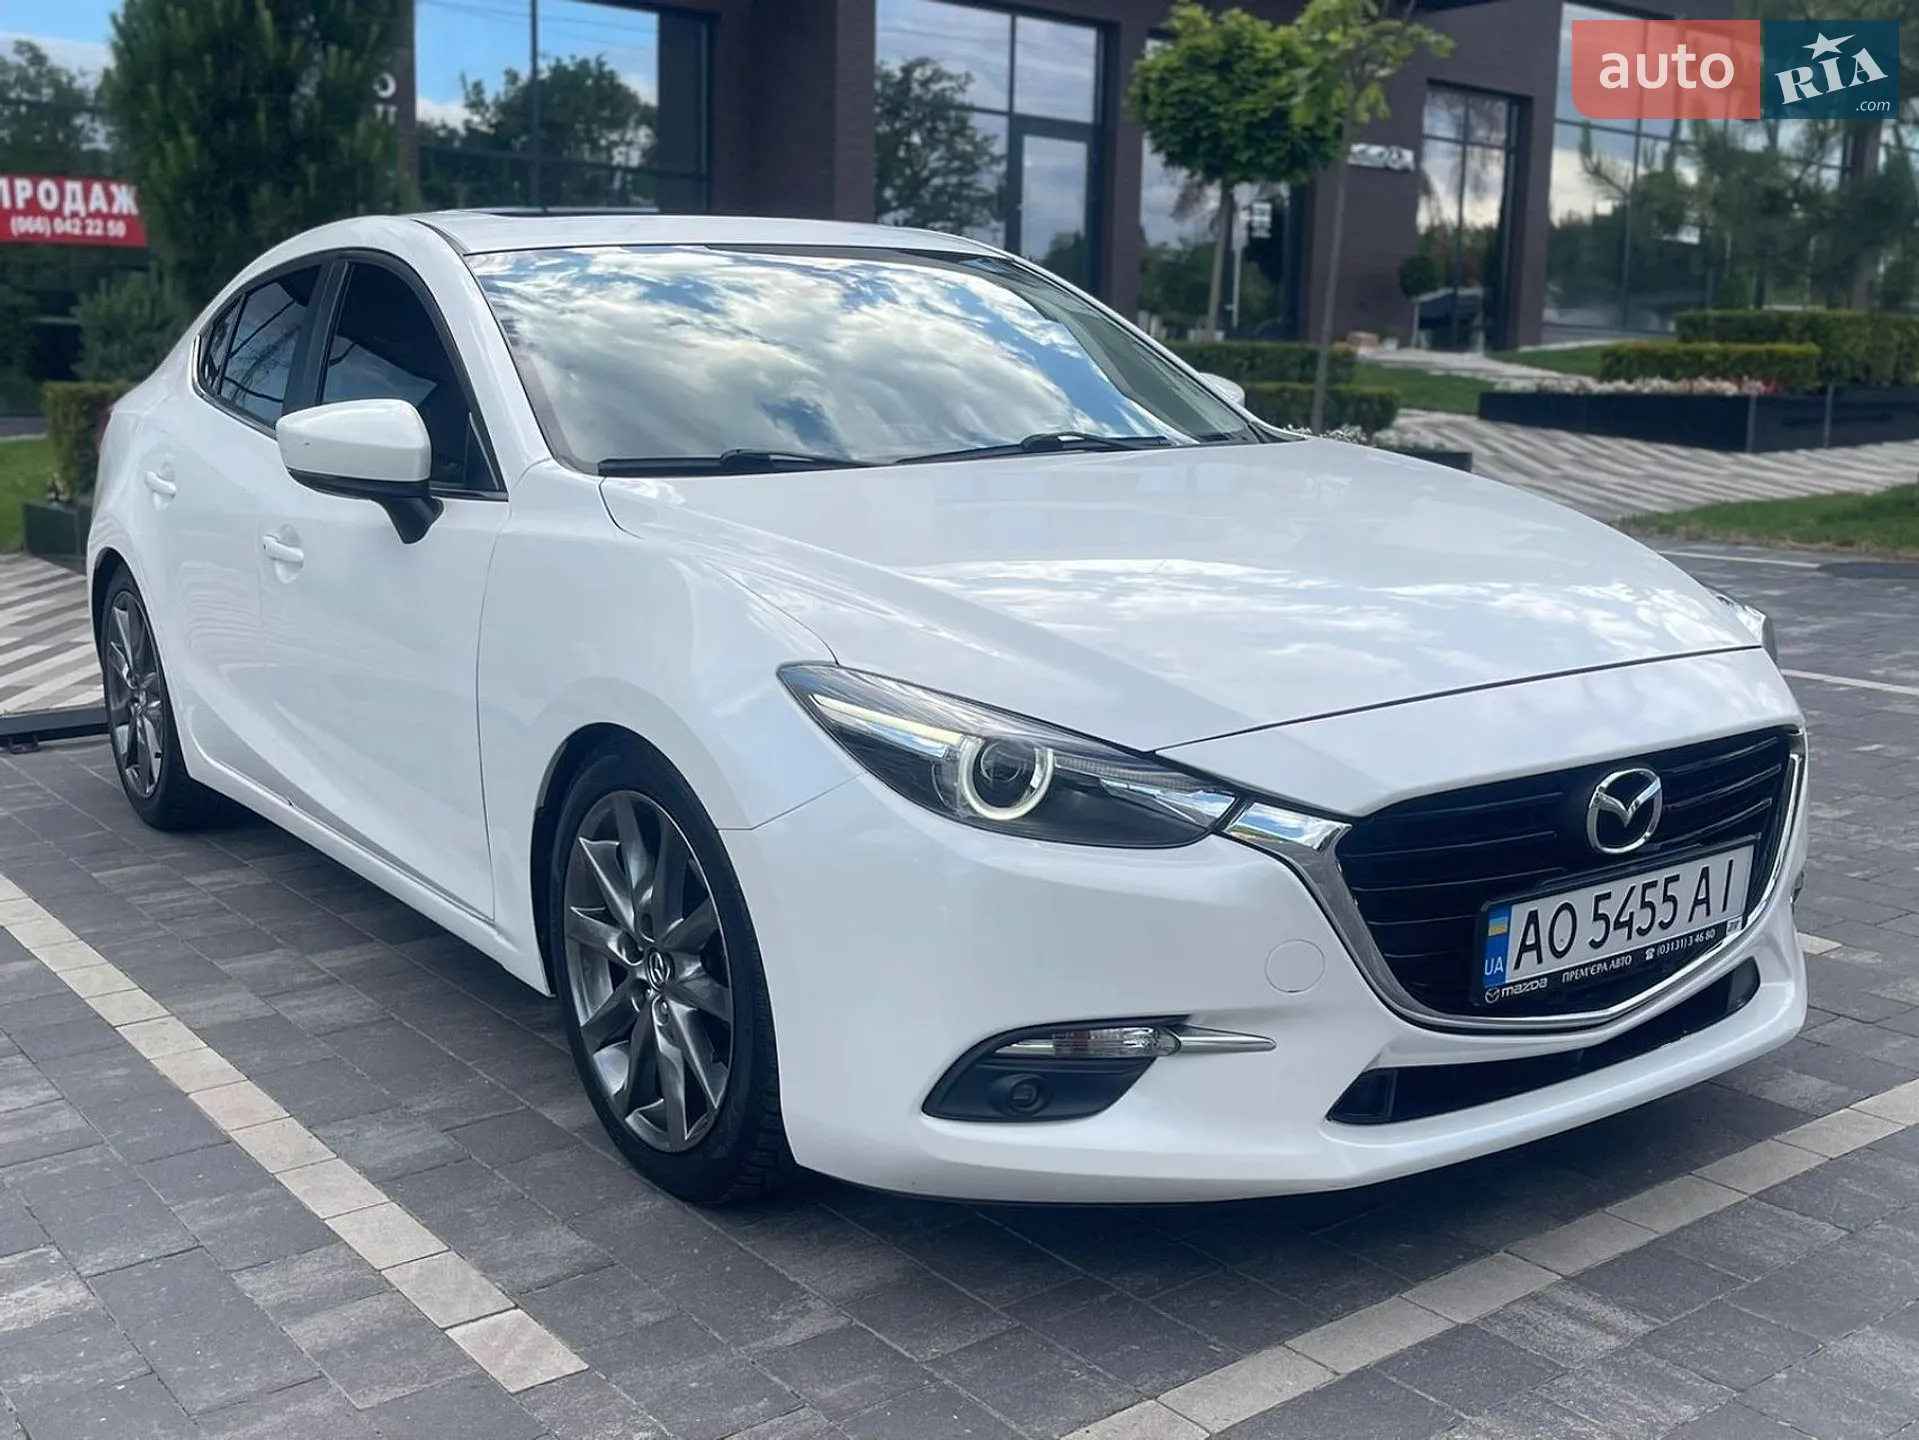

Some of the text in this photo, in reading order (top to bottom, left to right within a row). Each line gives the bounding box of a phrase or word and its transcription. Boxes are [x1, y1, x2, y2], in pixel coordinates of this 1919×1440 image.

[1513, 902, 1577, 970] AO
[1588, 874, 1680, 949] 5455
[1484, 957, 1504, 975] UA
[1501, 977, 1548, 998] mazda
